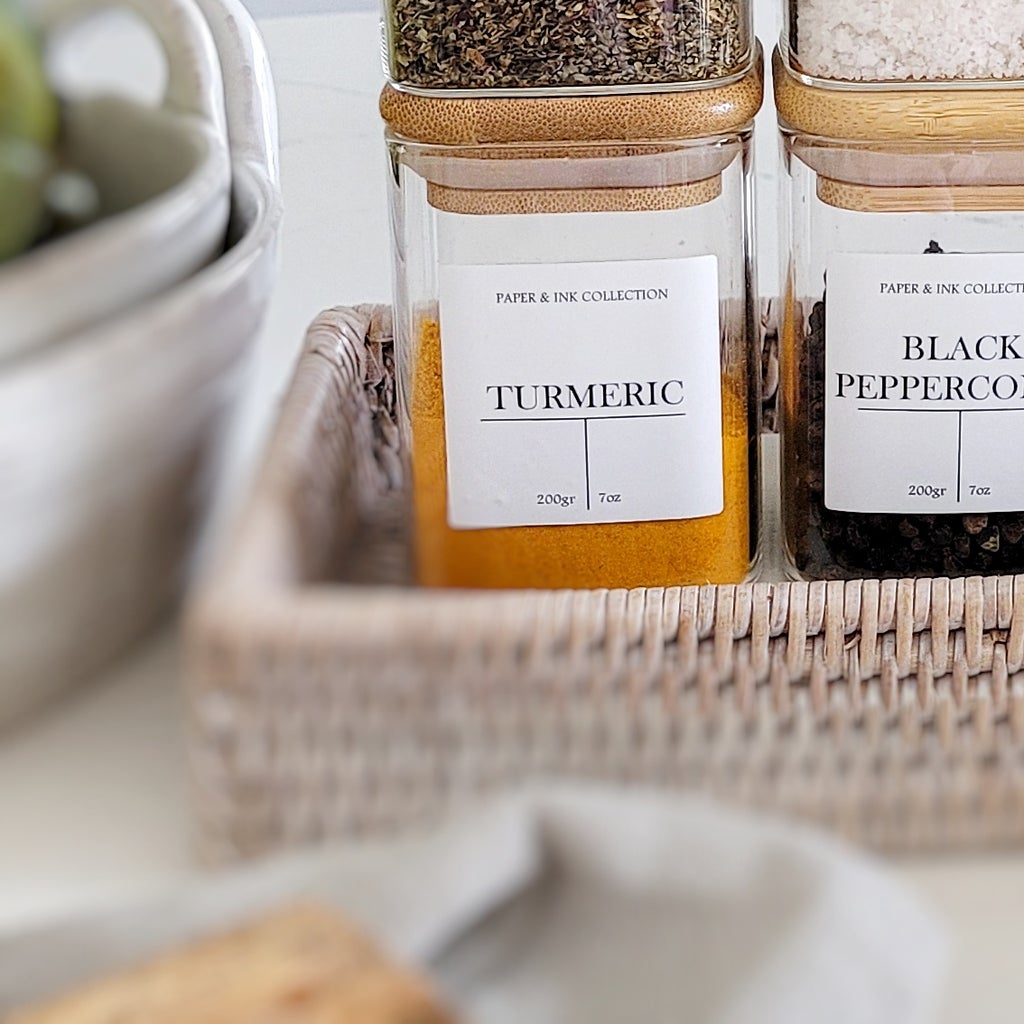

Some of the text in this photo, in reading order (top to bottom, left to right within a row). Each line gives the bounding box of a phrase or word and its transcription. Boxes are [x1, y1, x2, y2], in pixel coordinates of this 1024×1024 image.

[496, 288, 669, 304] PAPER & INK COLLECTION
[880, 283, 919, 294] PAPER
[922, 283, 933, 294] &
[936, 283, 960, 295] INK
[902, 334, 1024, 361] BLACK
[486, 379, 685, 411] TURMERIC
[536, 492, 622, 508] 200gr 7oz
[907, 484, 991, 500] 200gr 7oz
